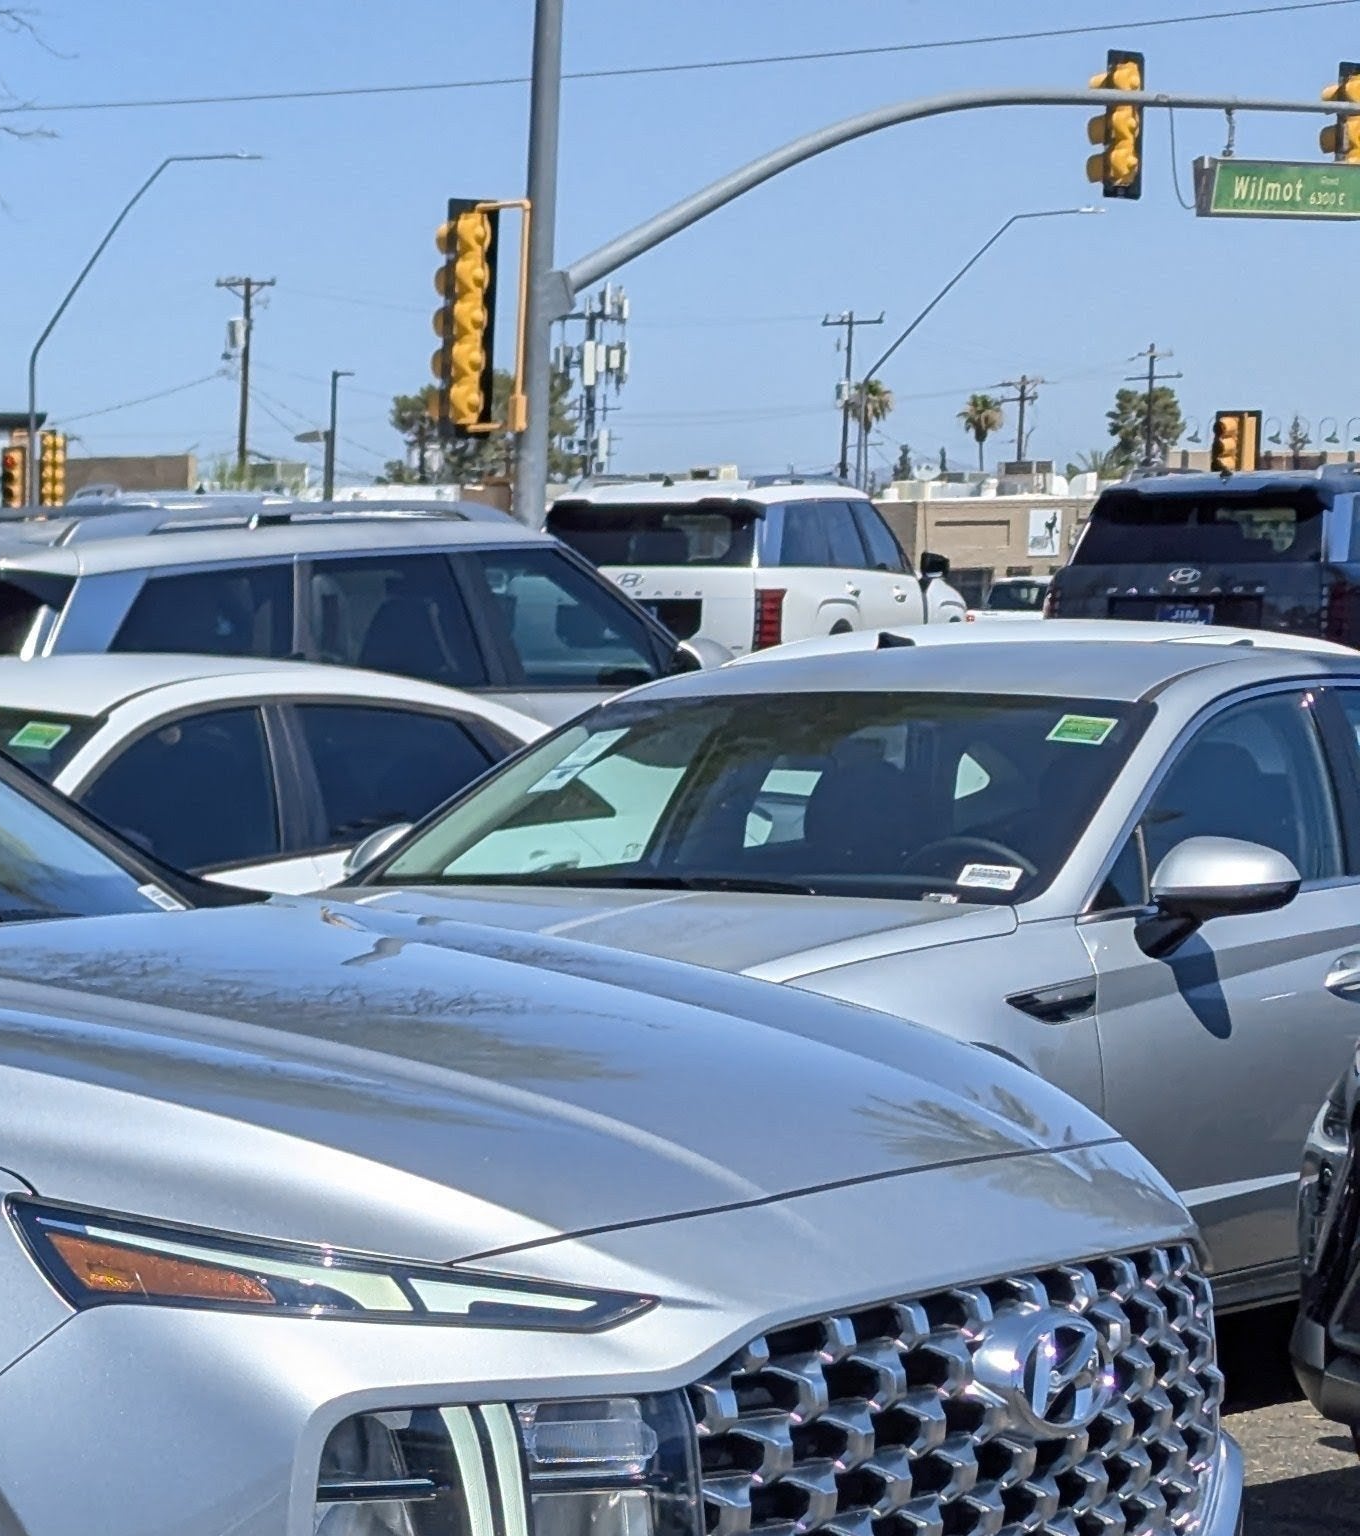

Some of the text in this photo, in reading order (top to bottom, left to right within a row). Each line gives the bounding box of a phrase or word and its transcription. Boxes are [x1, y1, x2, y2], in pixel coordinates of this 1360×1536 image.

[1234, 176, 1303, 201] Wilmot
[1106, 586, 1266, 594] PALISADE
[1171, 609, 1200, 620] JIM
